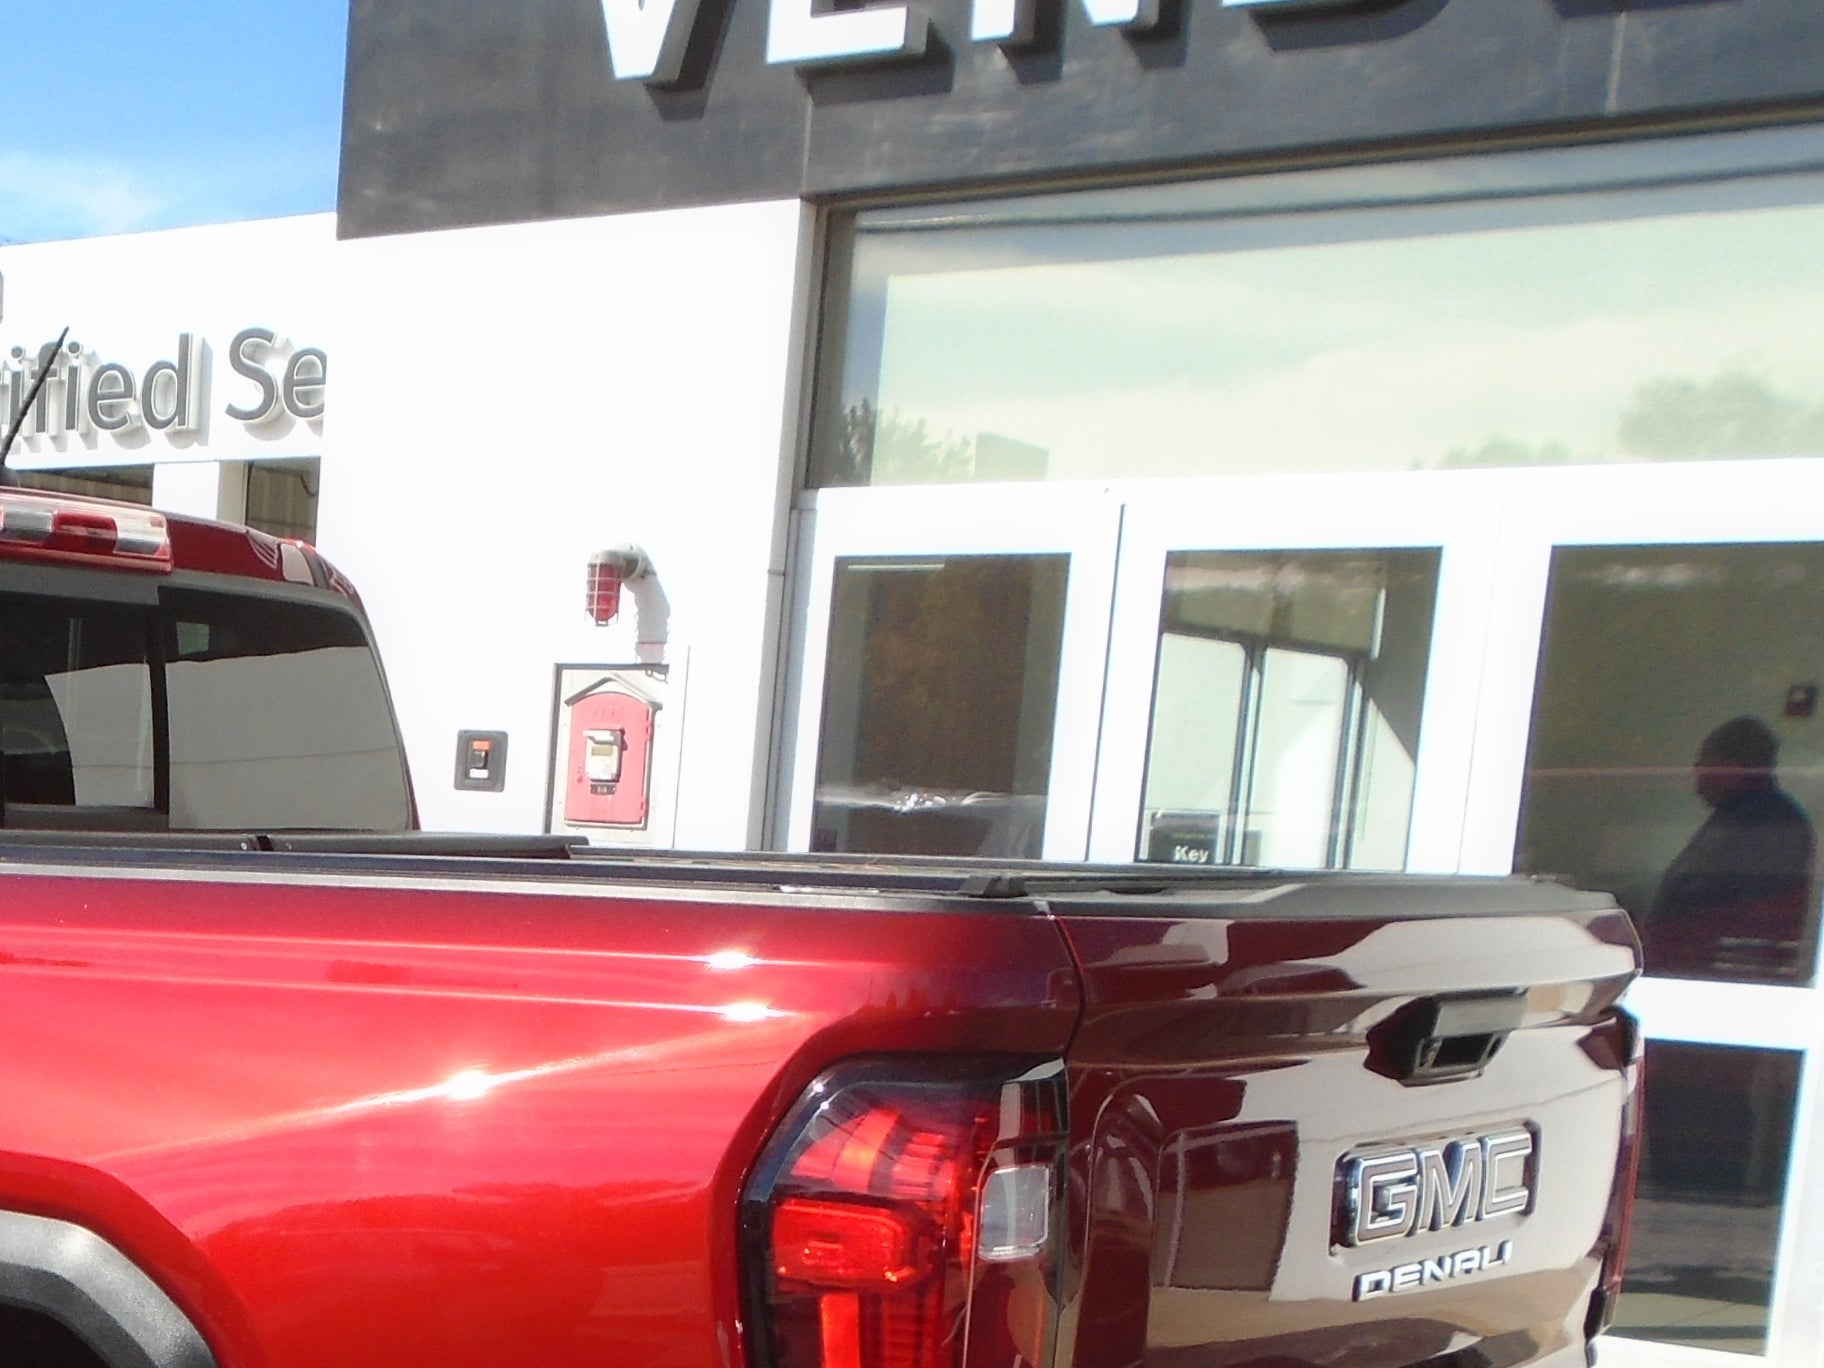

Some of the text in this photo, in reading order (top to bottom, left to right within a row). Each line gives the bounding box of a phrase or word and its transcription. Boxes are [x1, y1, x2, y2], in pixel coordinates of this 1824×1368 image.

[1175, 845, 1209, 863] Key
[1348, 1127, 1533, 1247] GMC
[1353, 1240, 1513, 1300] DENALI
